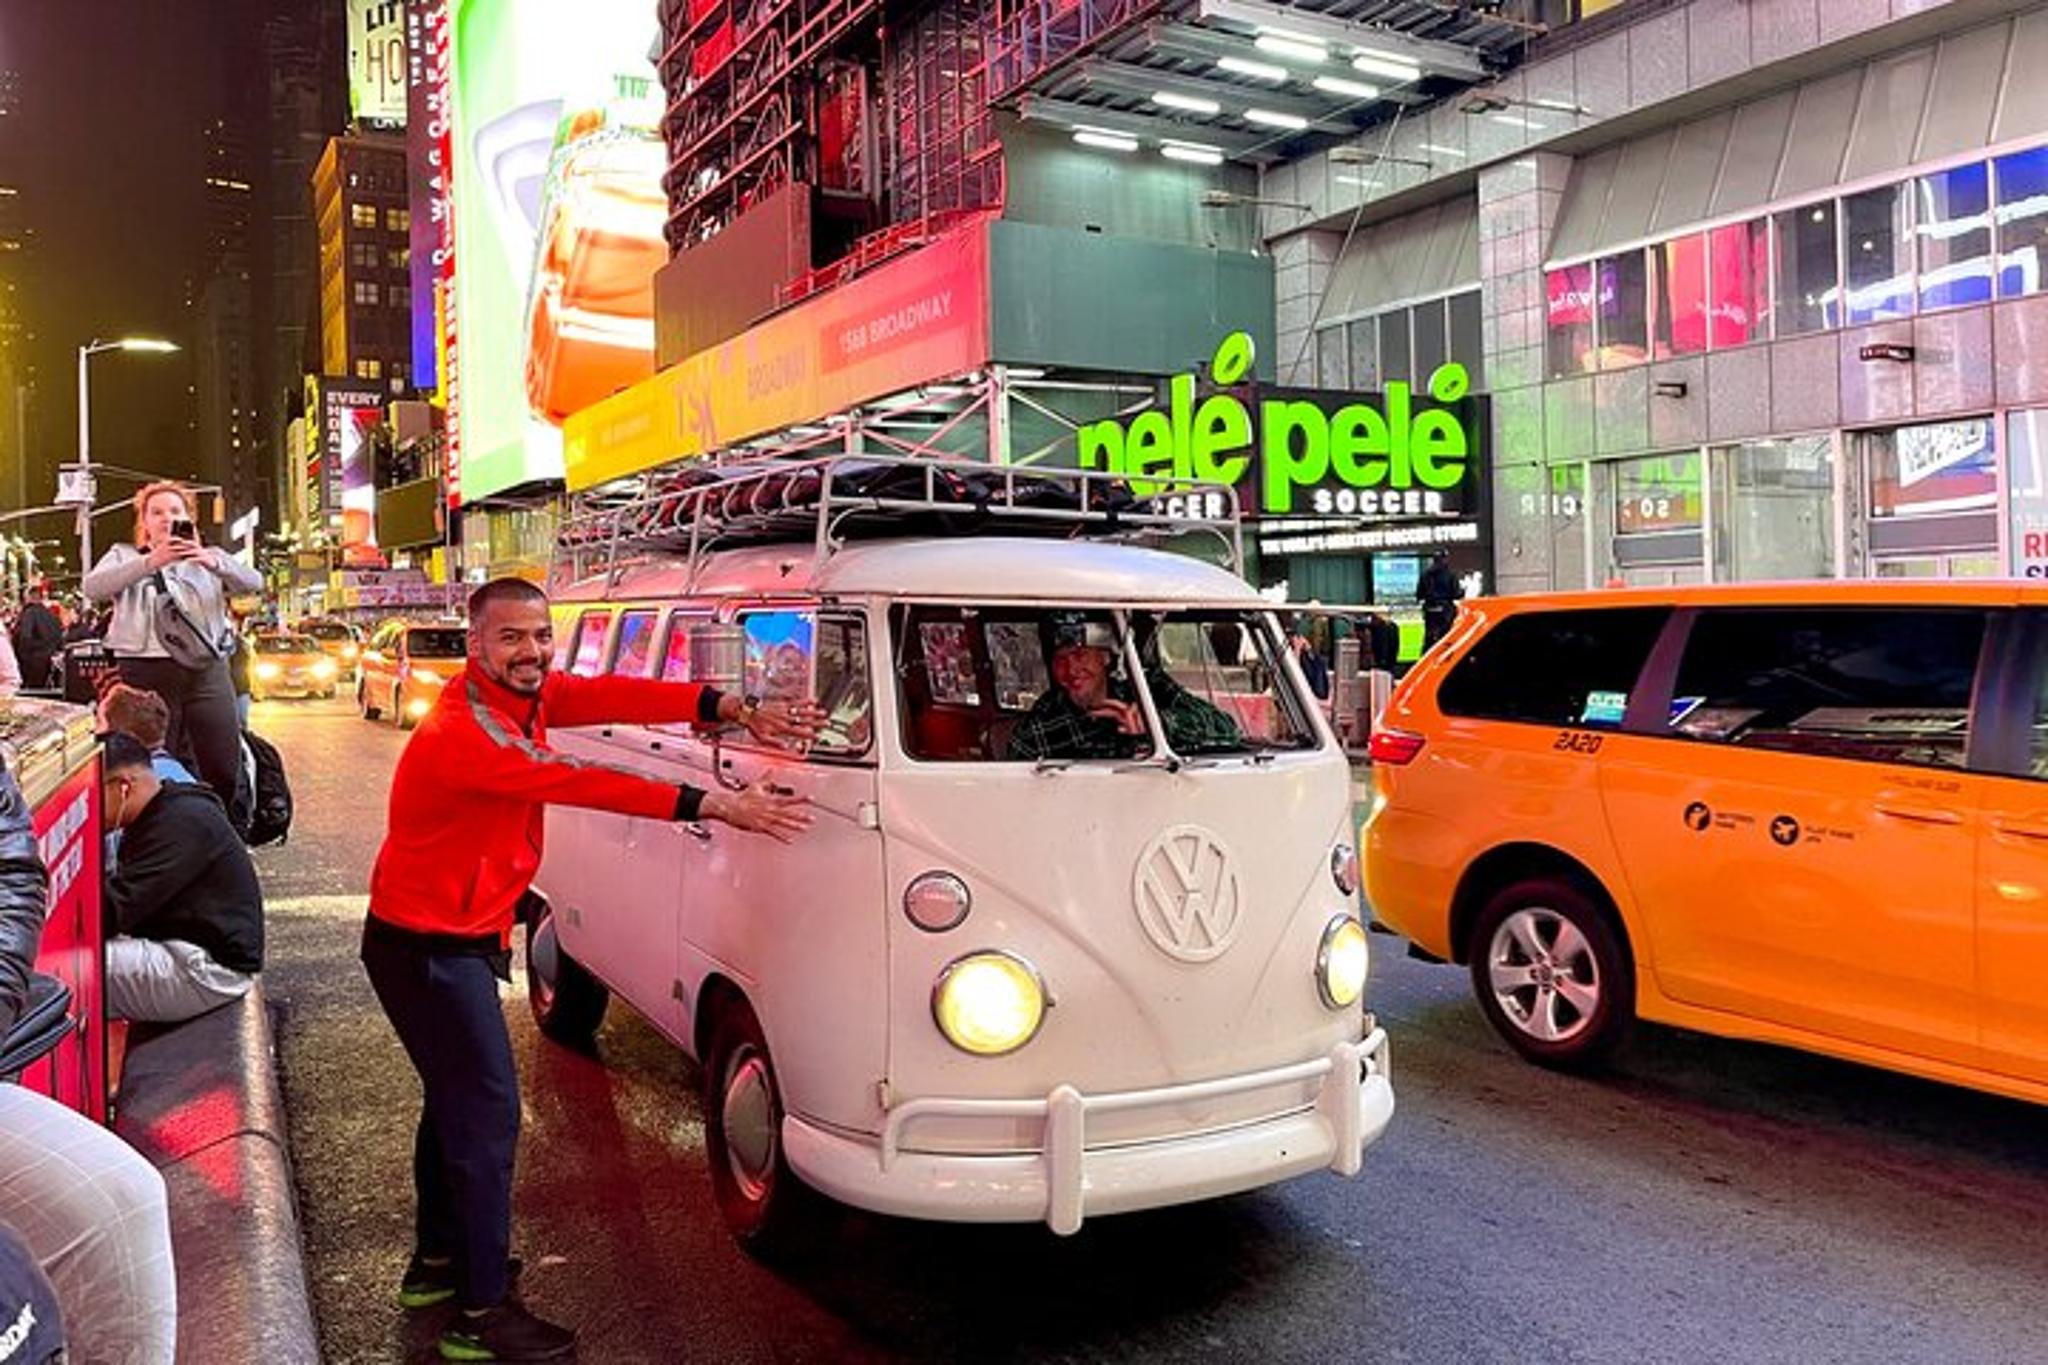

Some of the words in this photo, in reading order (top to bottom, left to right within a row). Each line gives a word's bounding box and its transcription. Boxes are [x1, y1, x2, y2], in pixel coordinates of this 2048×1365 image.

[423, 11, 442, 223] WAGONEER
[869, 288, 952, 343] BROADWAY
[326, 391, 383, 406] EVERY
[1261, 362, 1469, 513] pelé
[1314, 489, 1442, 514] SOCCER
[2025, 533, 2048, 558] R
